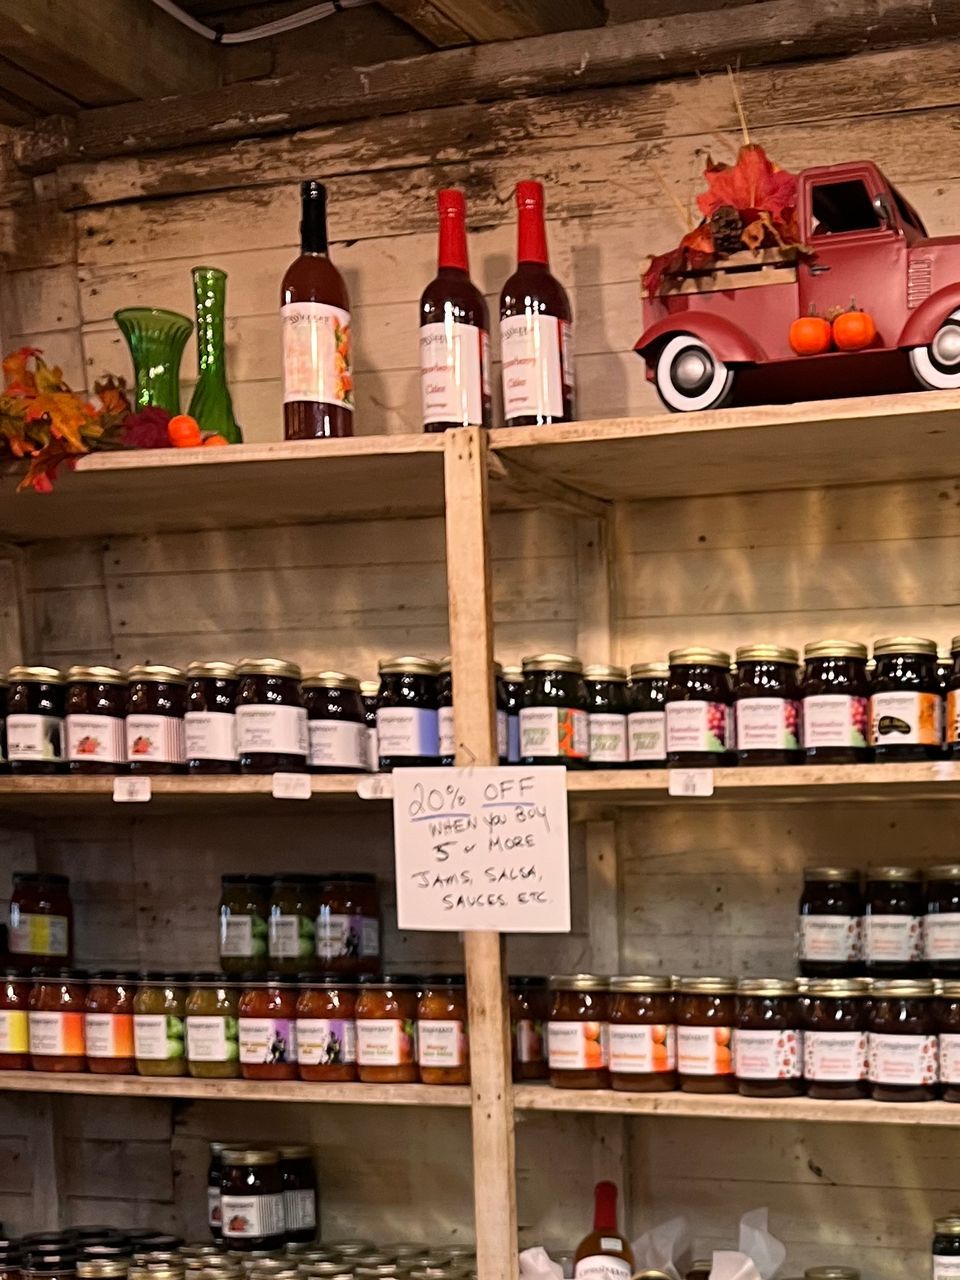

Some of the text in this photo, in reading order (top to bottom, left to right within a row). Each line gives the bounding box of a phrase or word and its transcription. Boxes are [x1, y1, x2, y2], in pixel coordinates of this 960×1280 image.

[408, 776, 535, 816] 20% OFF
[431, 817, 477, 837] WHEN
[433, 840, 458, 862] 5
[488, 834, 535, 852] MORE
[484, 865, 543, 883] SALSA,
